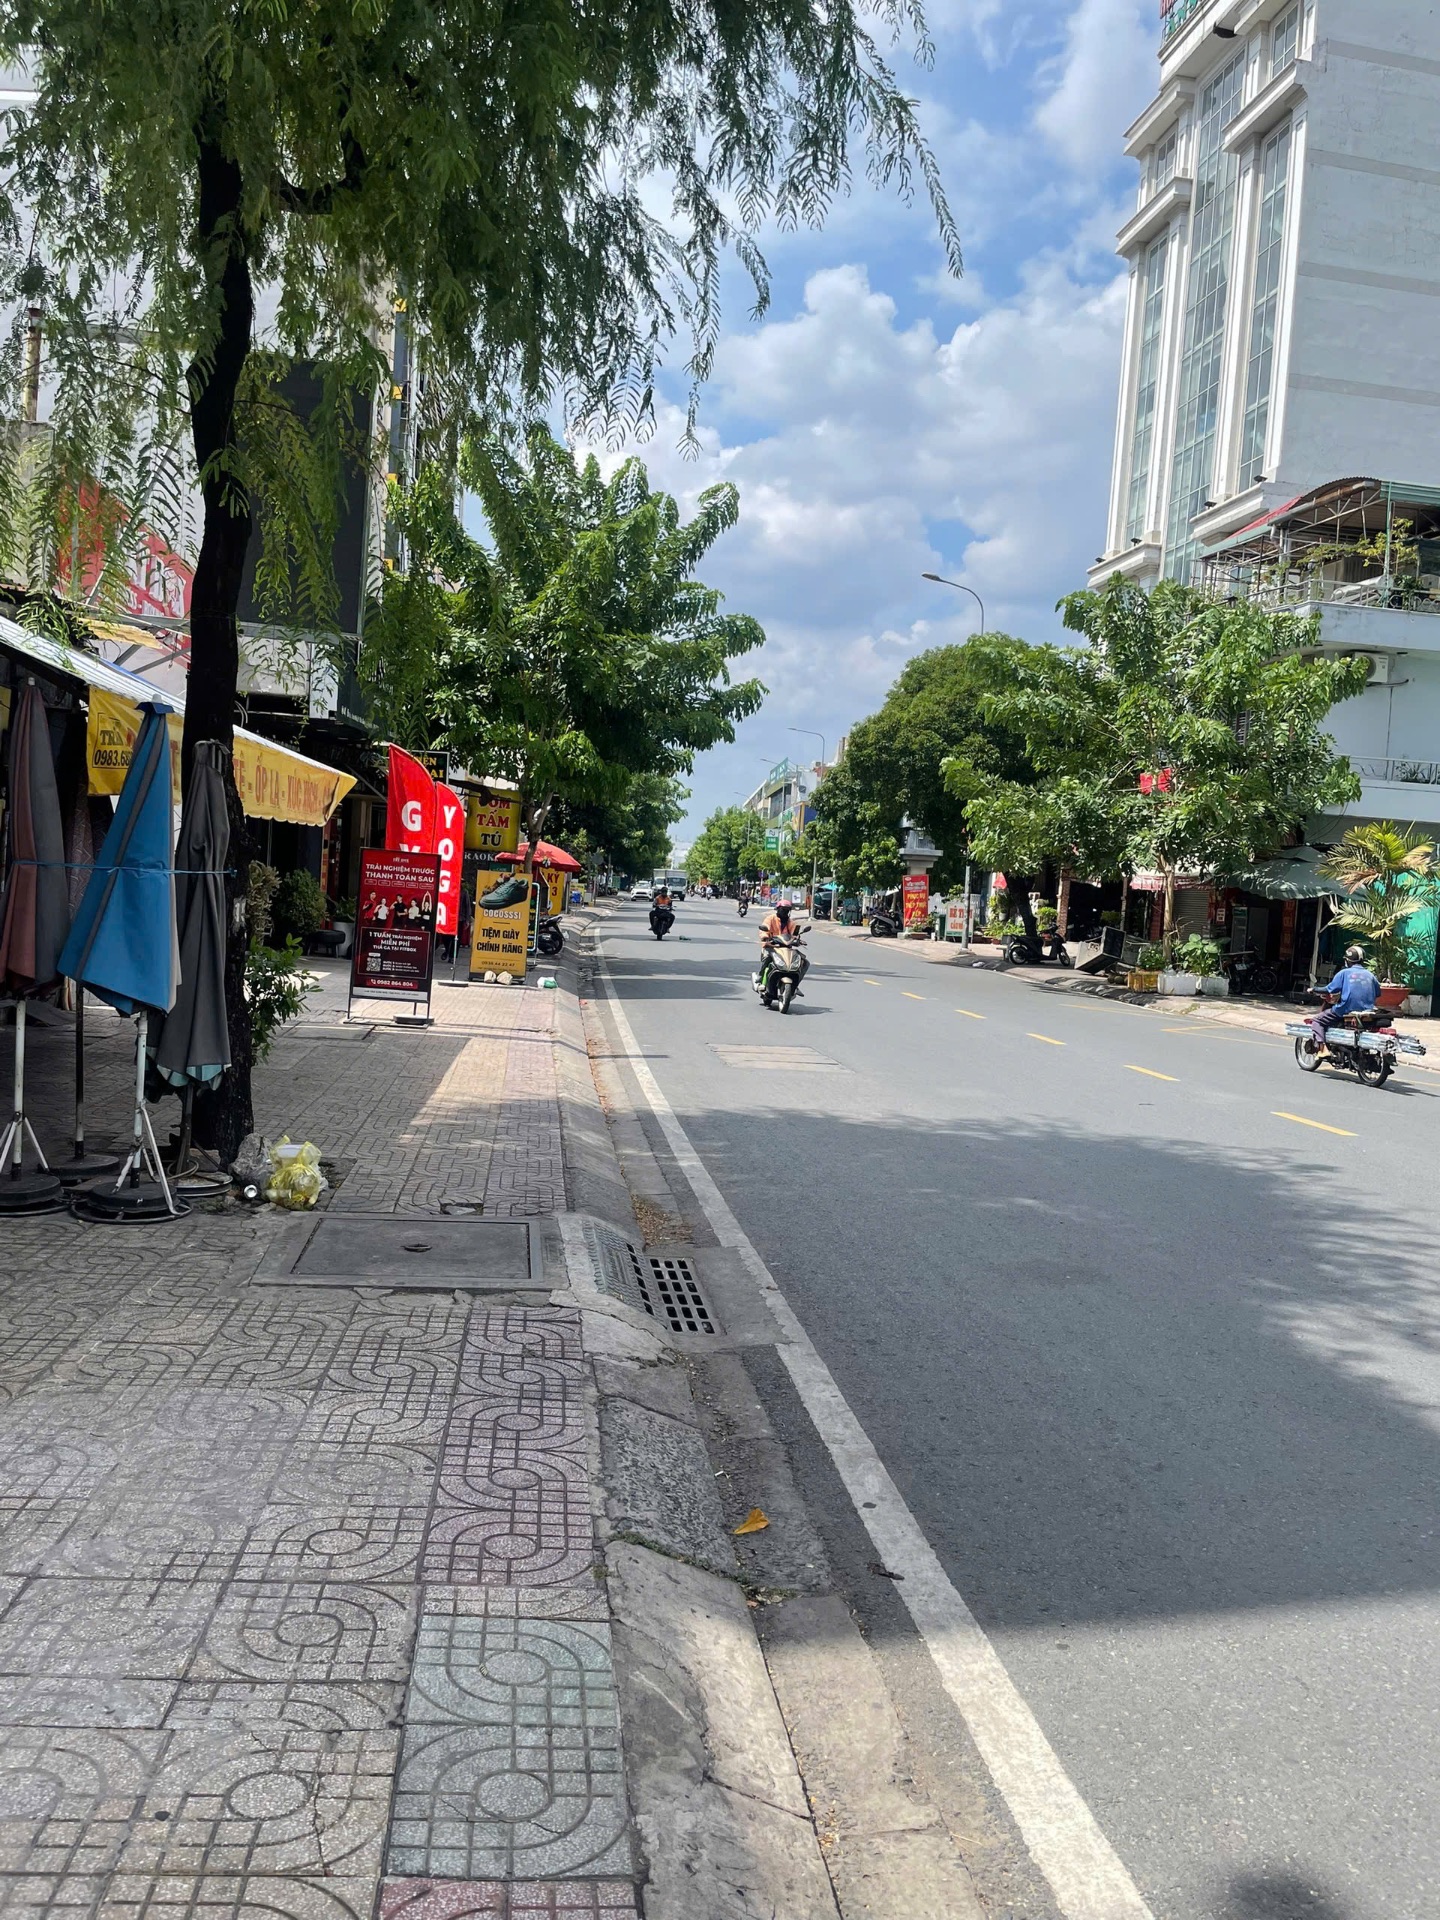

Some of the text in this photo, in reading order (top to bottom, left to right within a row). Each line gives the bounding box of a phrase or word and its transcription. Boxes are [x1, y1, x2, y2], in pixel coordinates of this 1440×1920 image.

[94, 750, 132, 767] 0983.68
[477, 810, 509, 828] TẤM
[481, 831, 502, 847] TÚ
[383, 865, 410, 873] NGHIỆM
[412, 867, 435, 875] TRƯỚC
[366, 871, 393, 880] THANH
[395, 873, 417, 882] TOÁN
[547, 871, 559, 883] KÝ
[552, 886, 557, 896] 3
[483, 909, 521, 919] COCOSSSI
[482, 927, 520, 940] TIỆM GIÀY
[398, 939, 411, 947] PHÍ
[477, 941, 500, 952] CHÍNH
[502, 942, 523, 954] HÃNG
